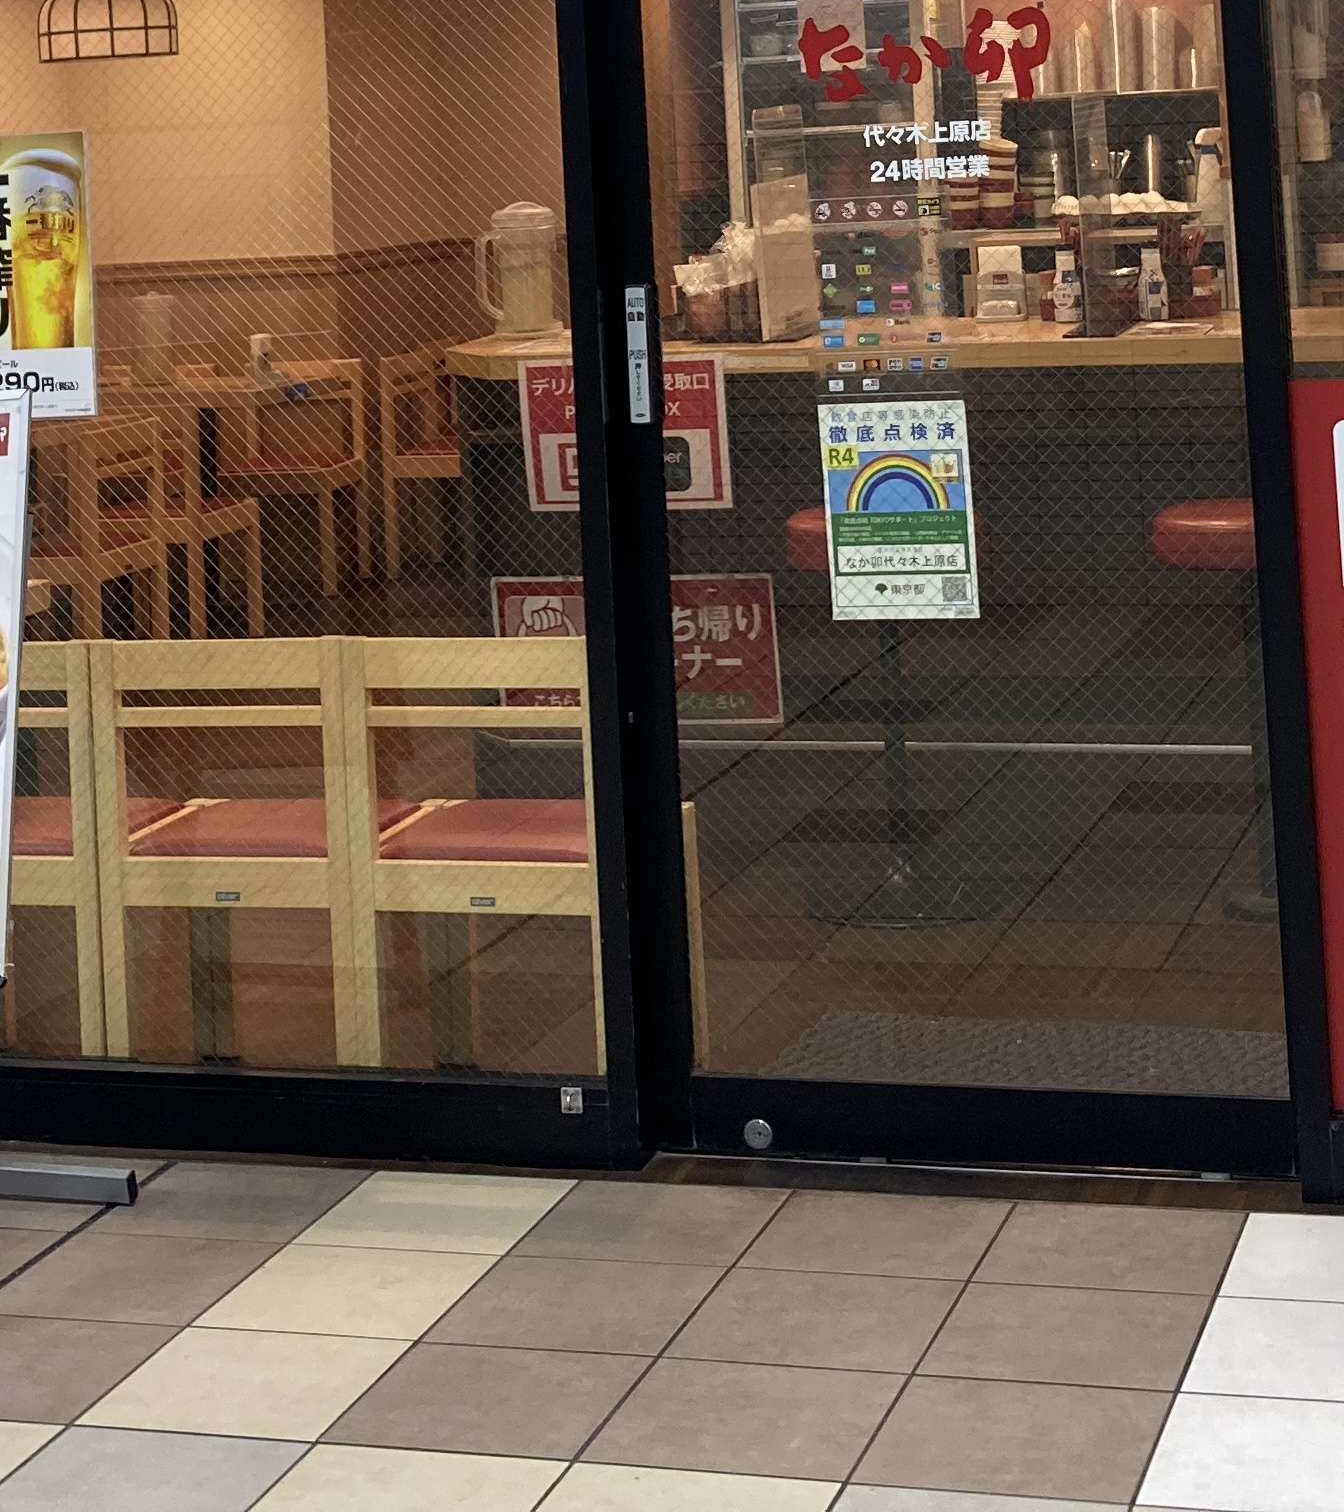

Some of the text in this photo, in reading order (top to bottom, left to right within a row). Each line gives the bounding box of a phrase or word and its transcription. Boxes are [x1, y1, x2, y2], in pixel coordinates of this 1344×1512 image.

[799, 6, 1051, 102] なか卯
[863, 118, 991, 149] 代々木上原店
[869, 154, 990, 184] 24時間営業
[627, 297, 644, 308] AUTO
[828, 422, 956, 444] 徹底点検済
[828, 447, 854, 465] R4
[846, 554, 958, 569] なか卯代々木上原店
[890, 583, 925, 596] 東京都
[675, 645, 743, 680] ナー
